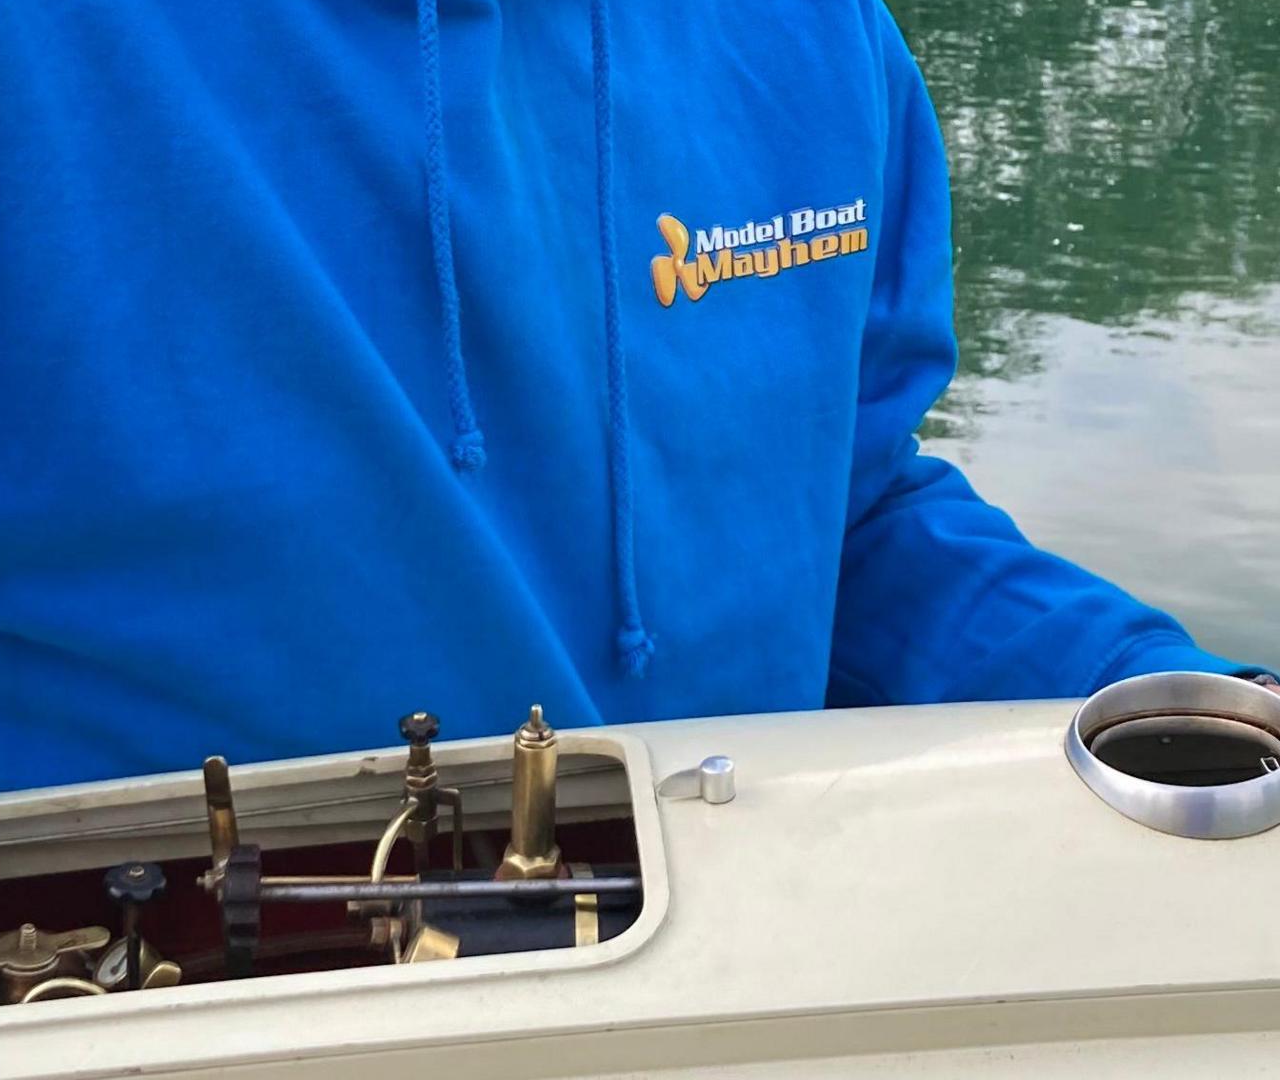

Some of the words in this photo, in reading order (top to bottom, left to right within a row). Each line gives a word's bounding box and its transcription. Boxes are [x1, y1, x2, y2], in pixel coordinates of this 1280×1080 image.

[696, 216, 784, 253] Model
[790, 198, 866, 236] Boat
[697, 228, 868, 284] Mayhem
